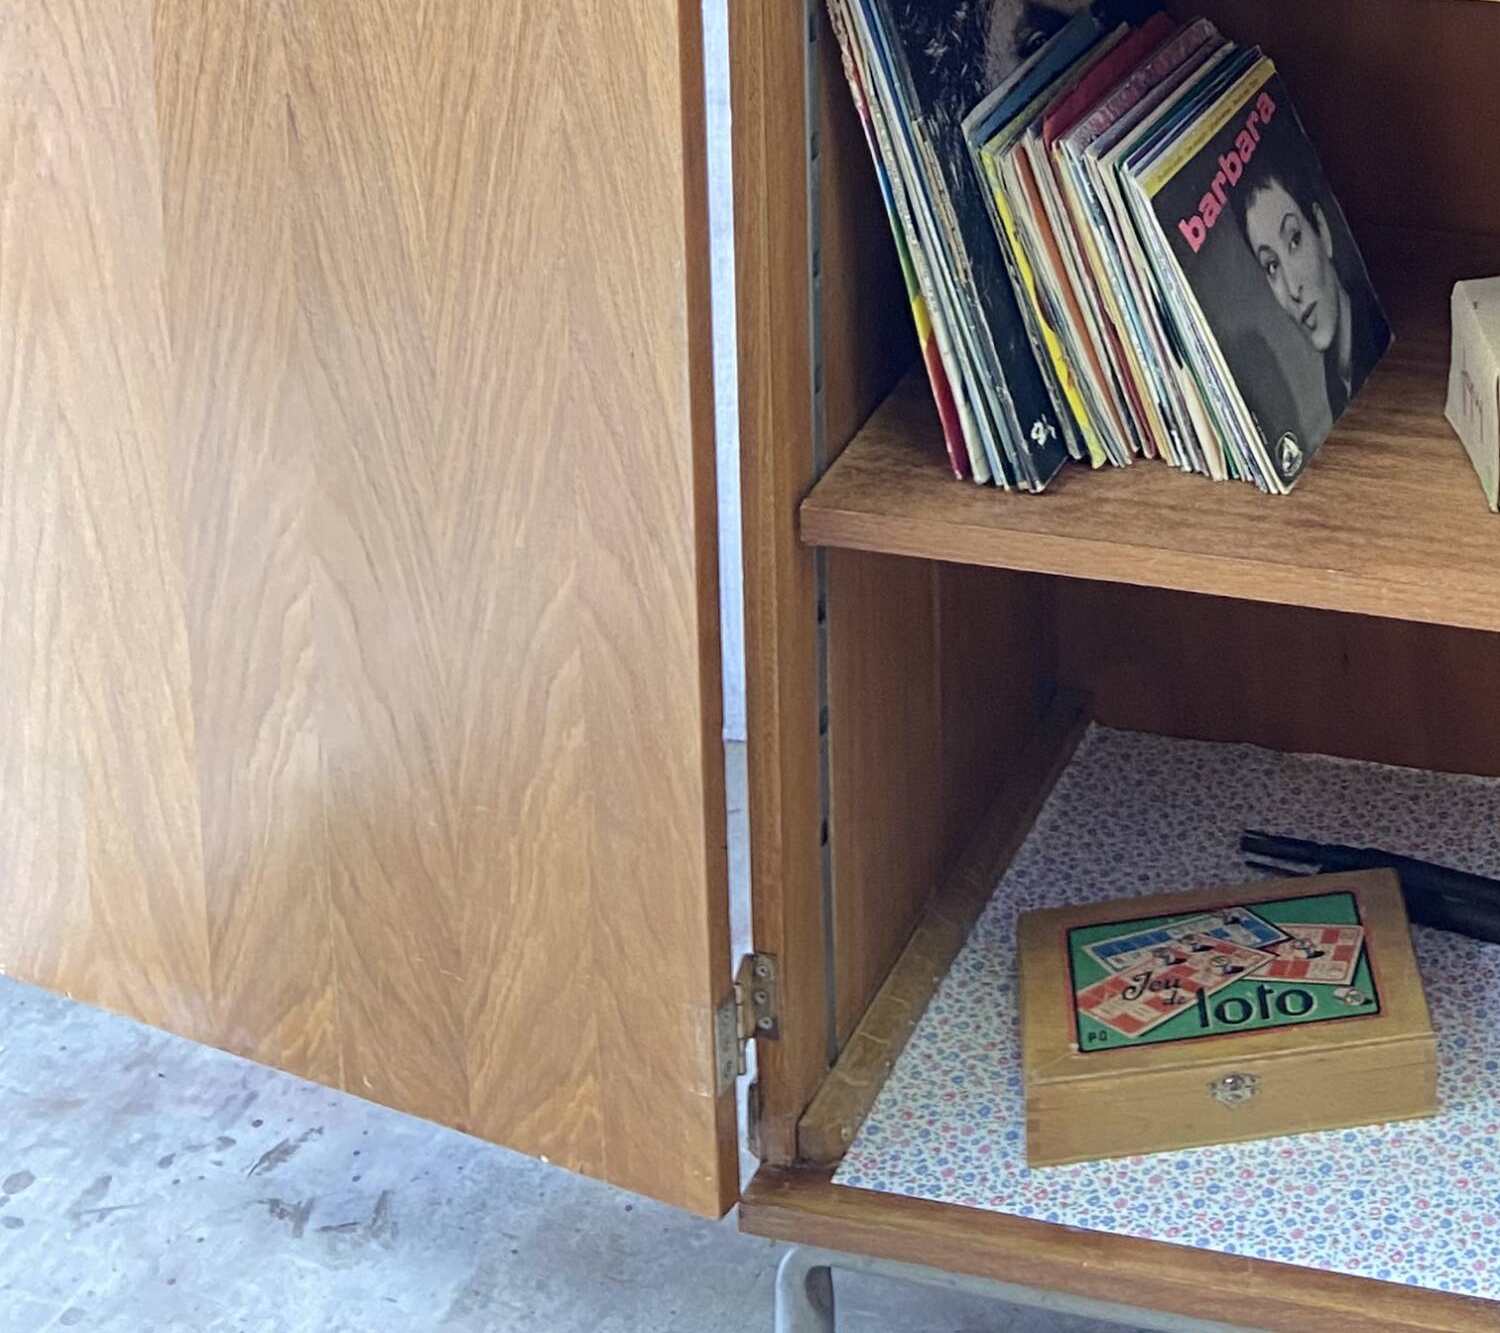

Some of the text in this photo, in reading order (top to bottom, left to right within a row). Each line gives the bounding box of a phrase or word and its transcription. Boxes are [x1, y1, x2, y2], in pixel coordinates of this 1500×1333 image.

[1177, 91, 1277, 254] barbara
[1121, 970, 1182, 1002] Jeu
[1162, 989, 1188, 1006] de
[1195, 983, 1316, 1029] loto
